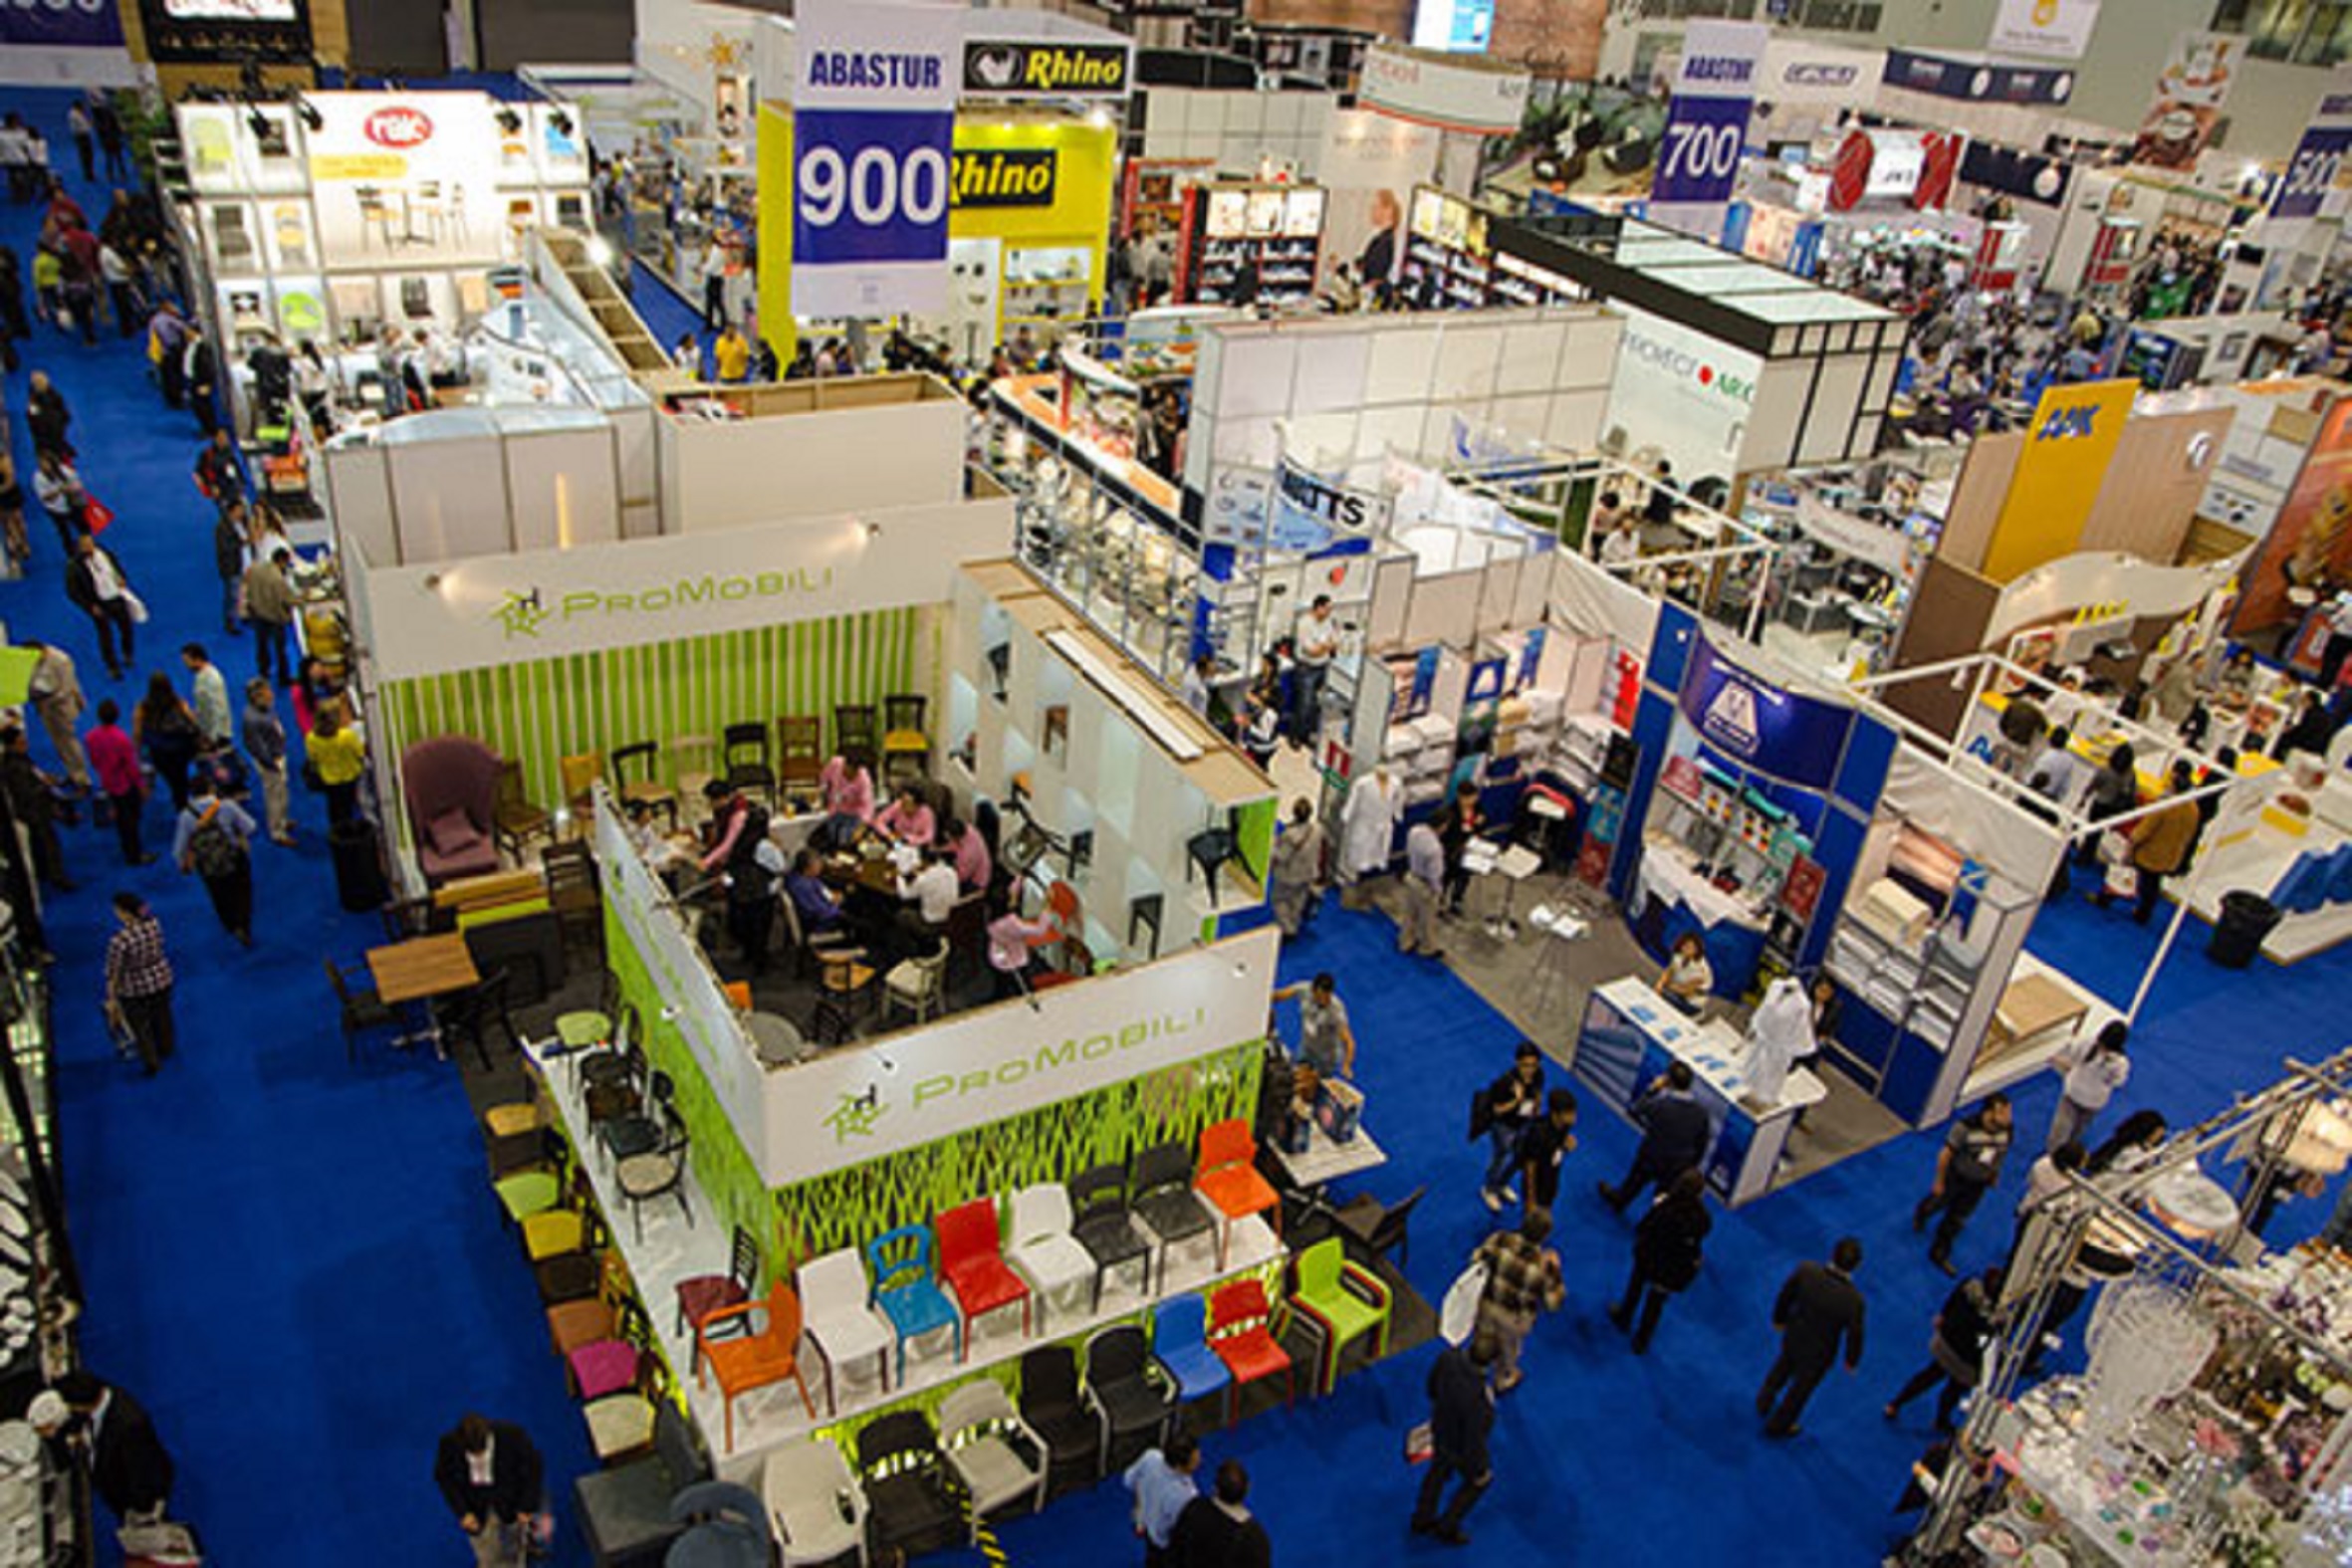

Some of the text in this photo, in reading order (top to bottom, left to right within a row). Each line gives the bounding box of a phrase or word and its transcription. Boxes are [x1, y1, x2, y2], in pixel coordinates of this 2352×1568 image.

[809, 52, 941, 88] ABASTUR
[1026, 50, 1122, 89] Rhino
[1664, 122, 1741, 178] 700
[2287, 150, 2340, 195] 500
[799, 145, 947, 217] 900
